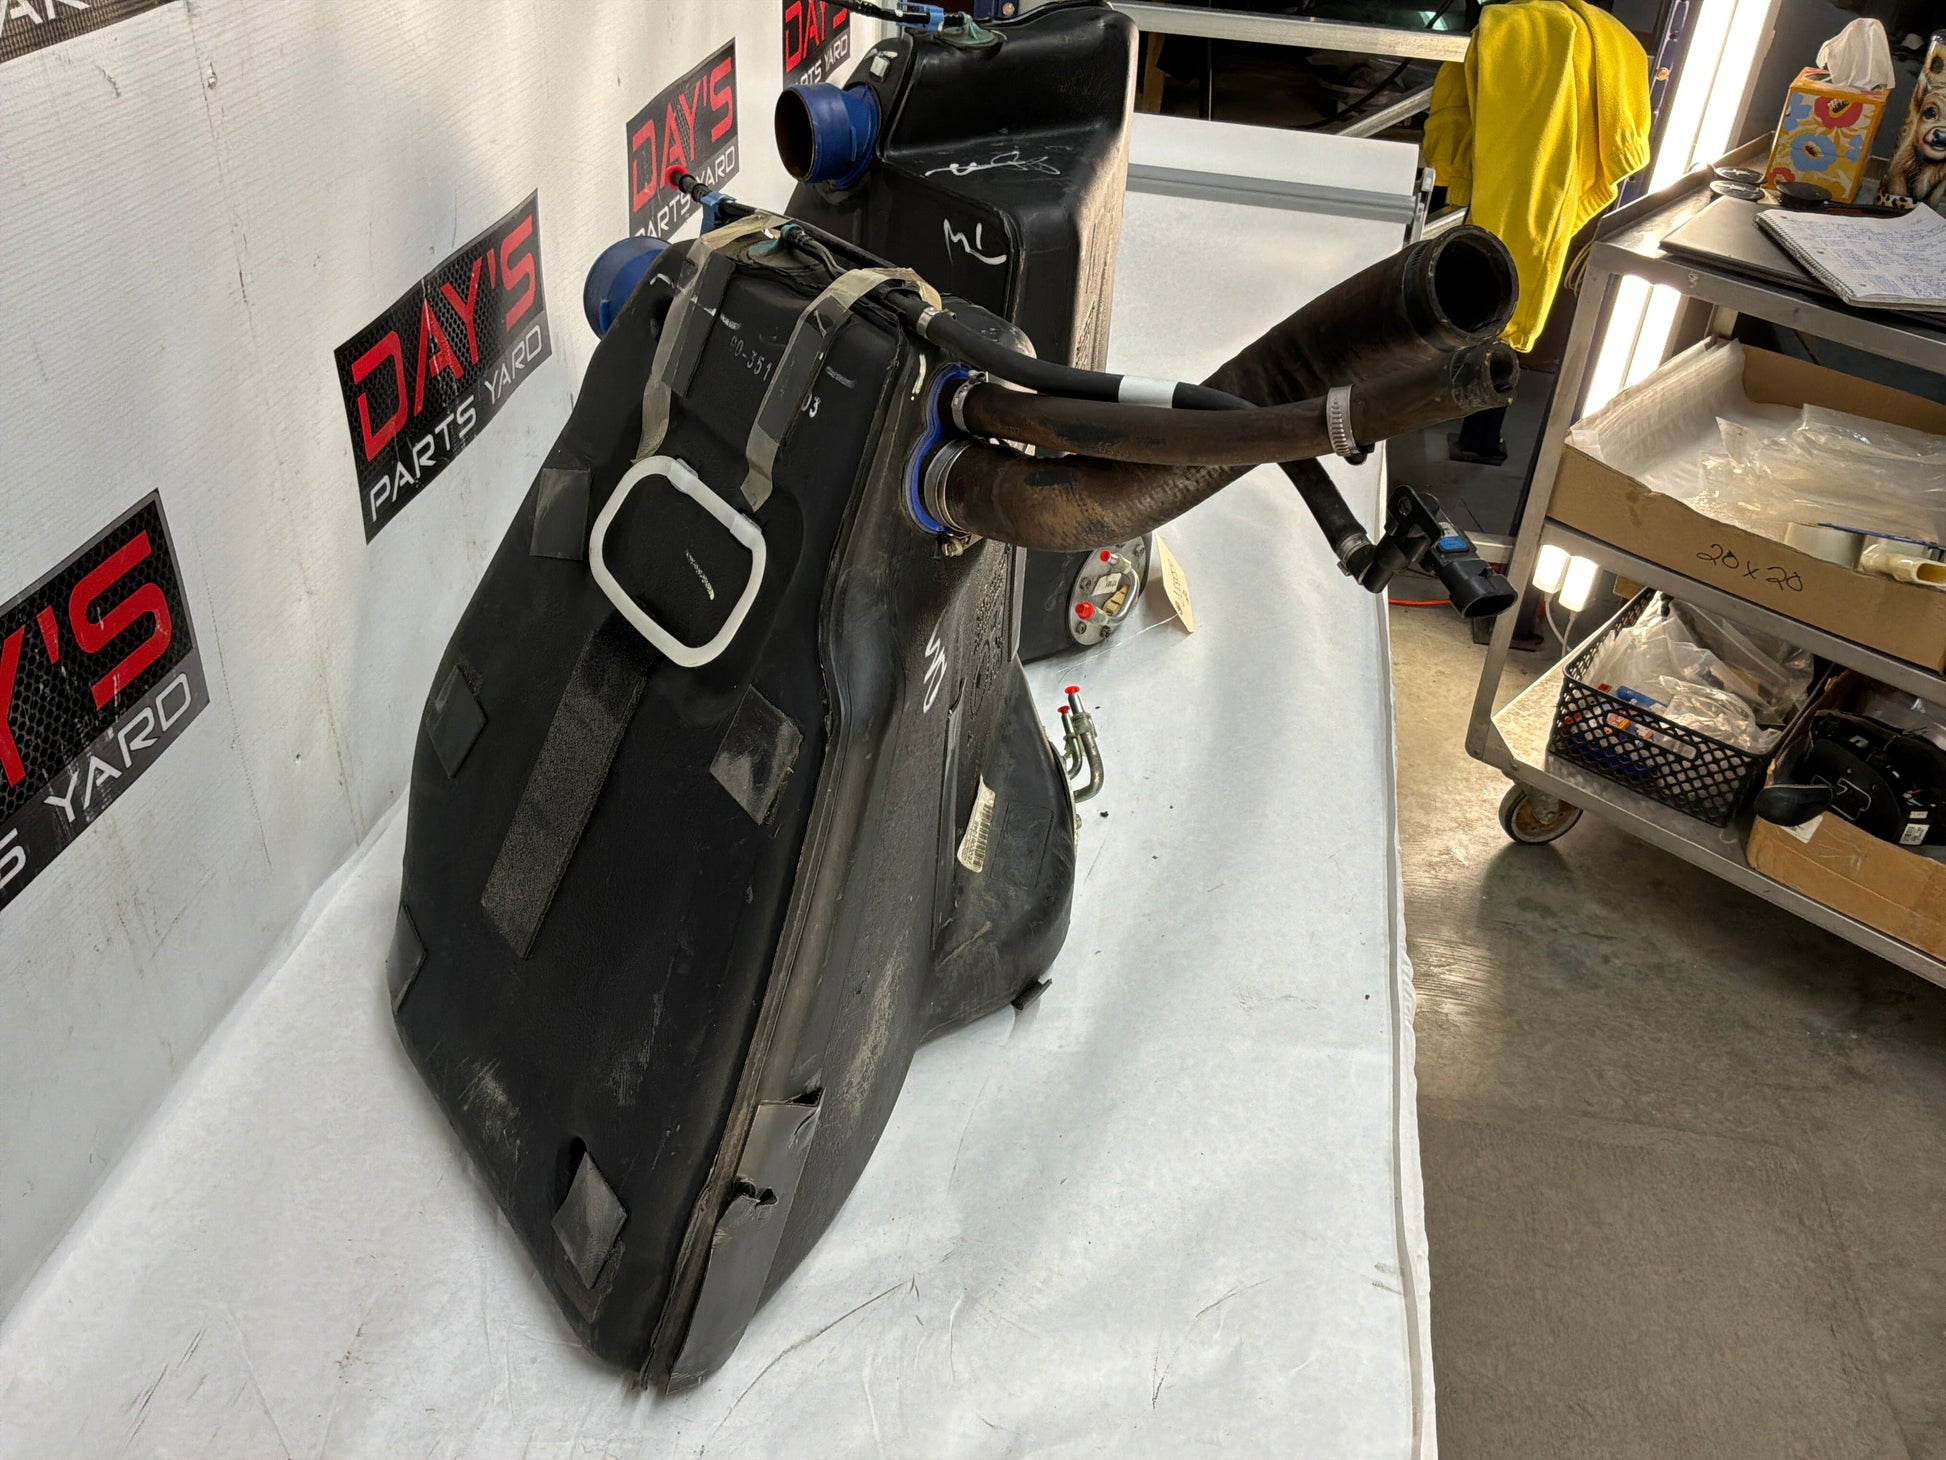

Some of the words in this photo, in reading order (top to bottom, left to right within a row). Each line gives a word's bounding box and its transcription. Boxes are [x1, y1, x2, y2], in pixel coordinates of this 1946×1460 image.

[824, 34, 848, 72] YARD
[632, 57, 734, 213] DAY'S
[351, 215, 536, 462] DAY'S
[369, 394, 478, 522] PARTS
[484, 324, 543, 405] YARD
[1696, 543, 1739, 569] 20
[1765, 566, 1803, 592] 20
[43, 672, 191, 824] YARD
